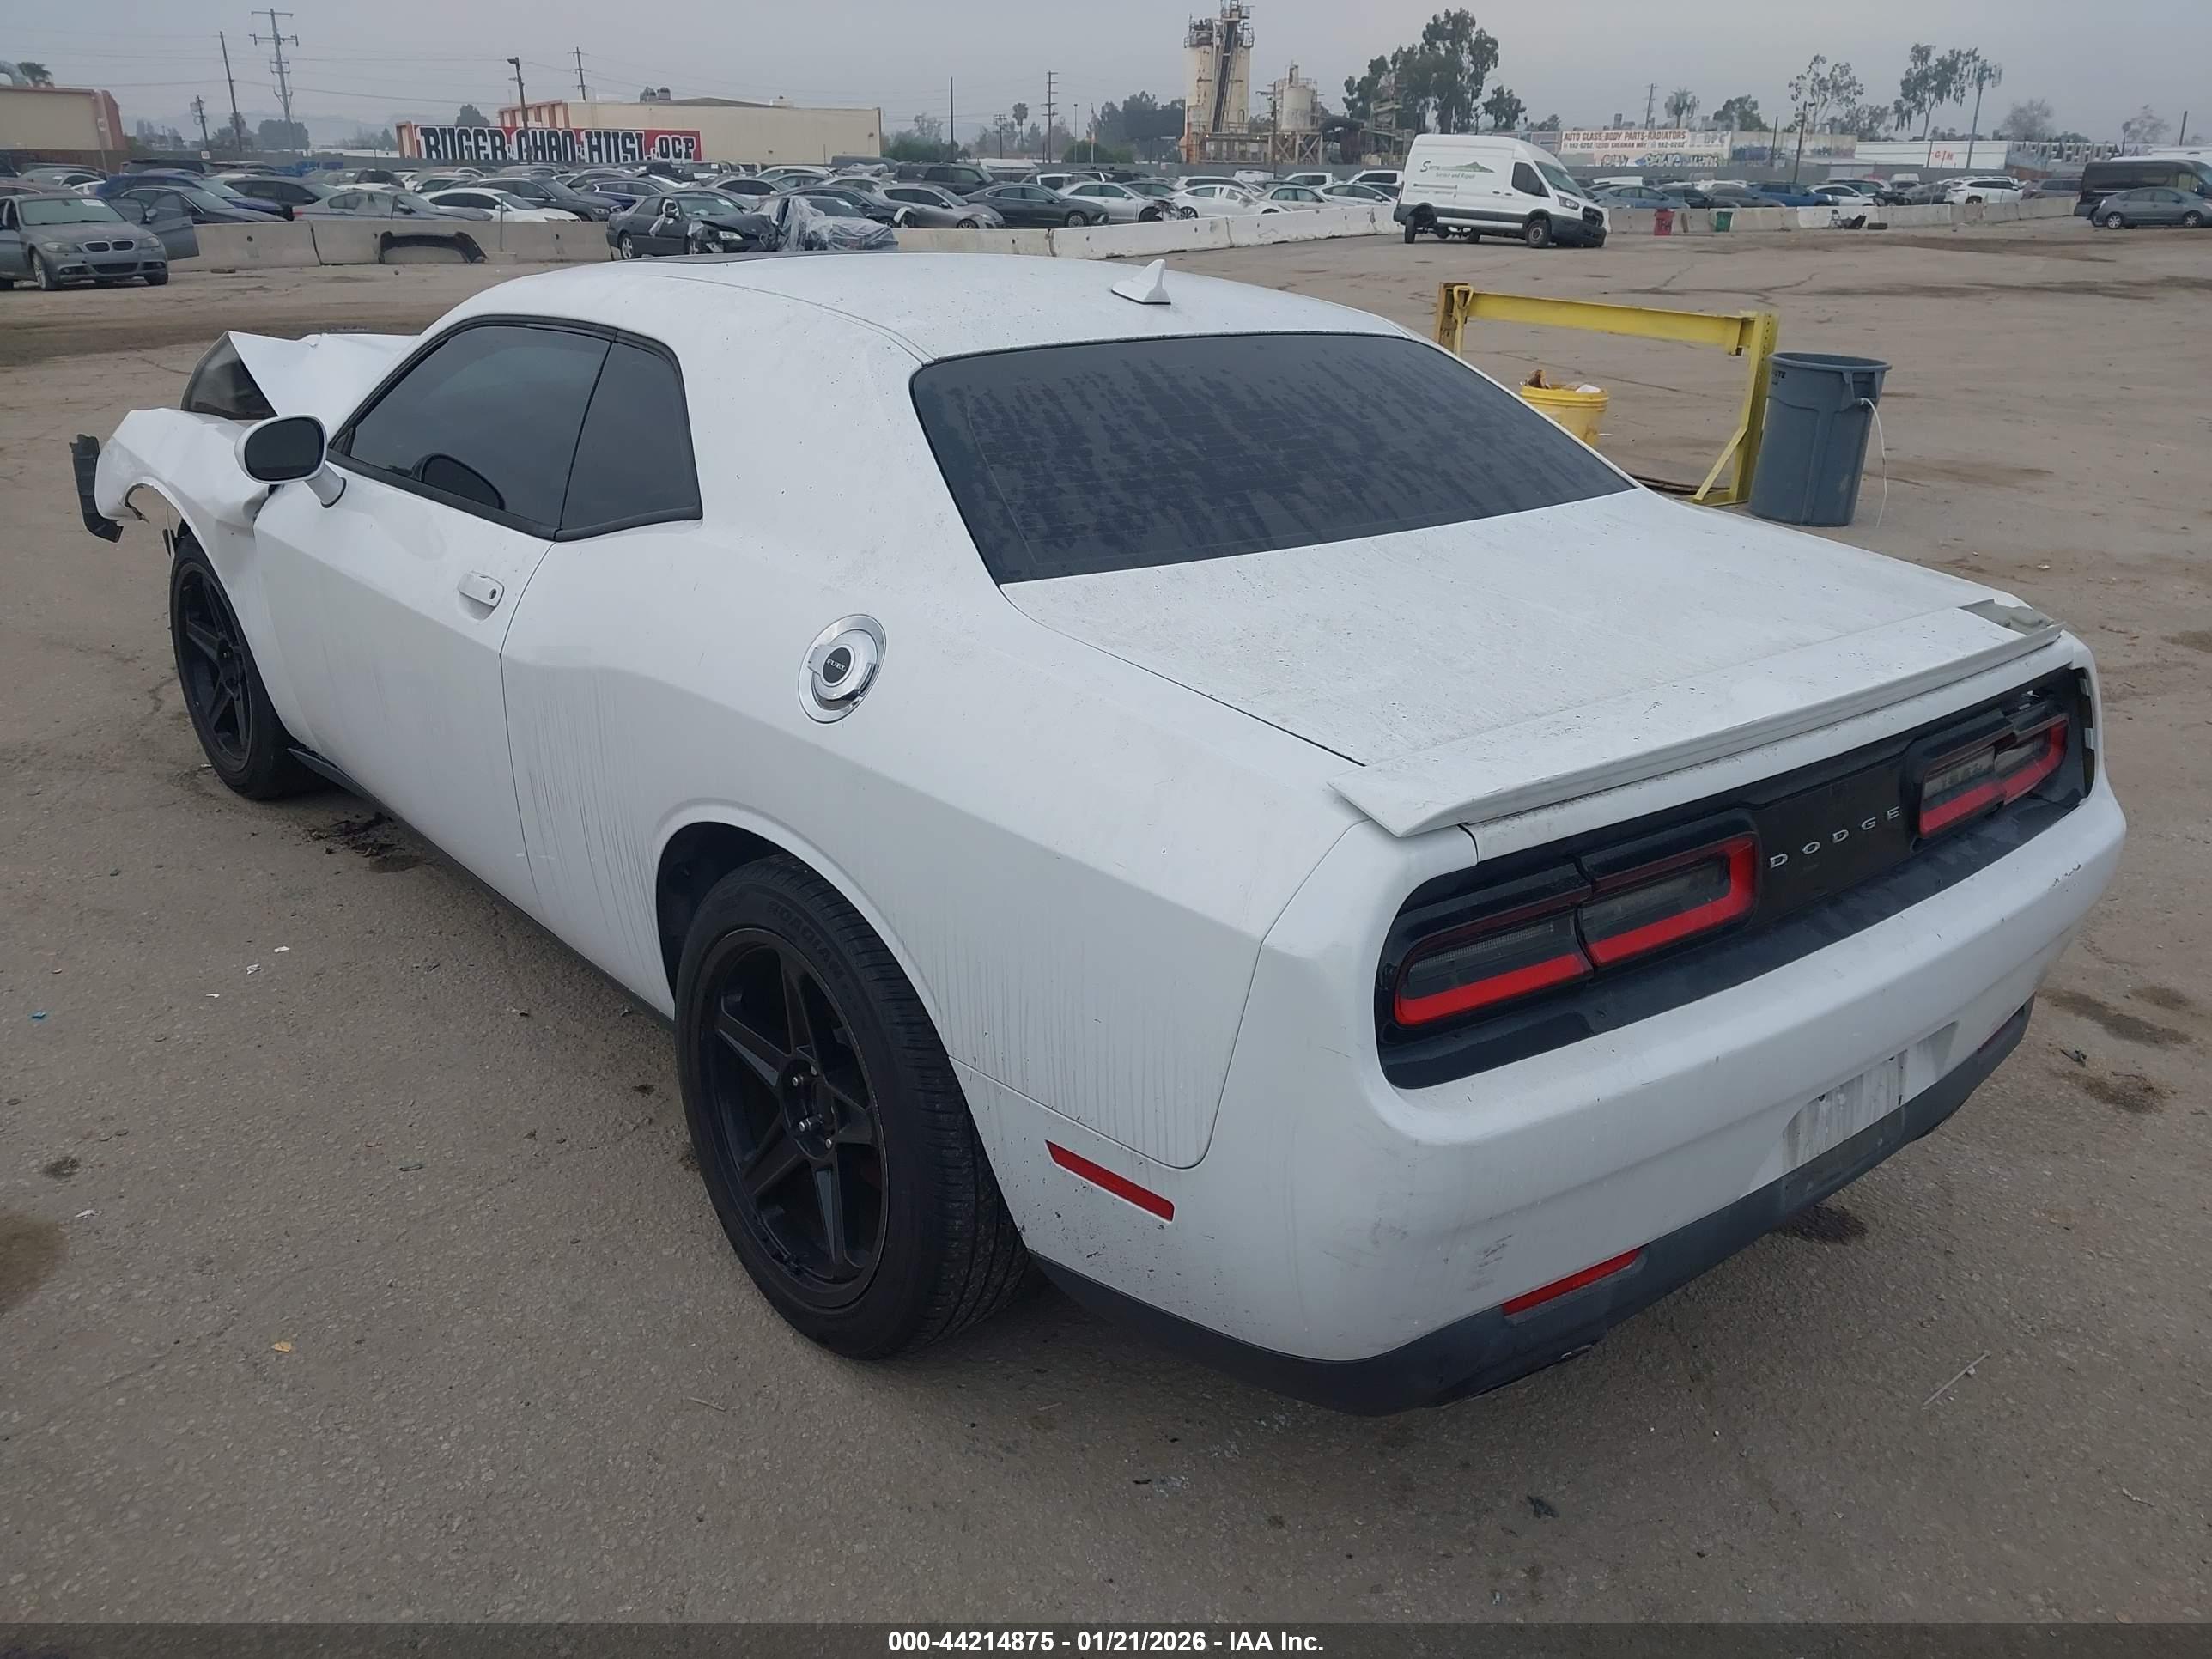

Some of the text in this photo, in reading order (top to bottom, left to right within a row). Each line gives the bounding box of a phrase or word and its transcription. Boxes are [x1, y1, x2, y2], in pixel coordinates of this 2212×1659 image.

[1564, 132, 1580, 142] AUTO
[826, 658, 847, 672] FUEL
[1769, 805, 1901, 869] DODGE
